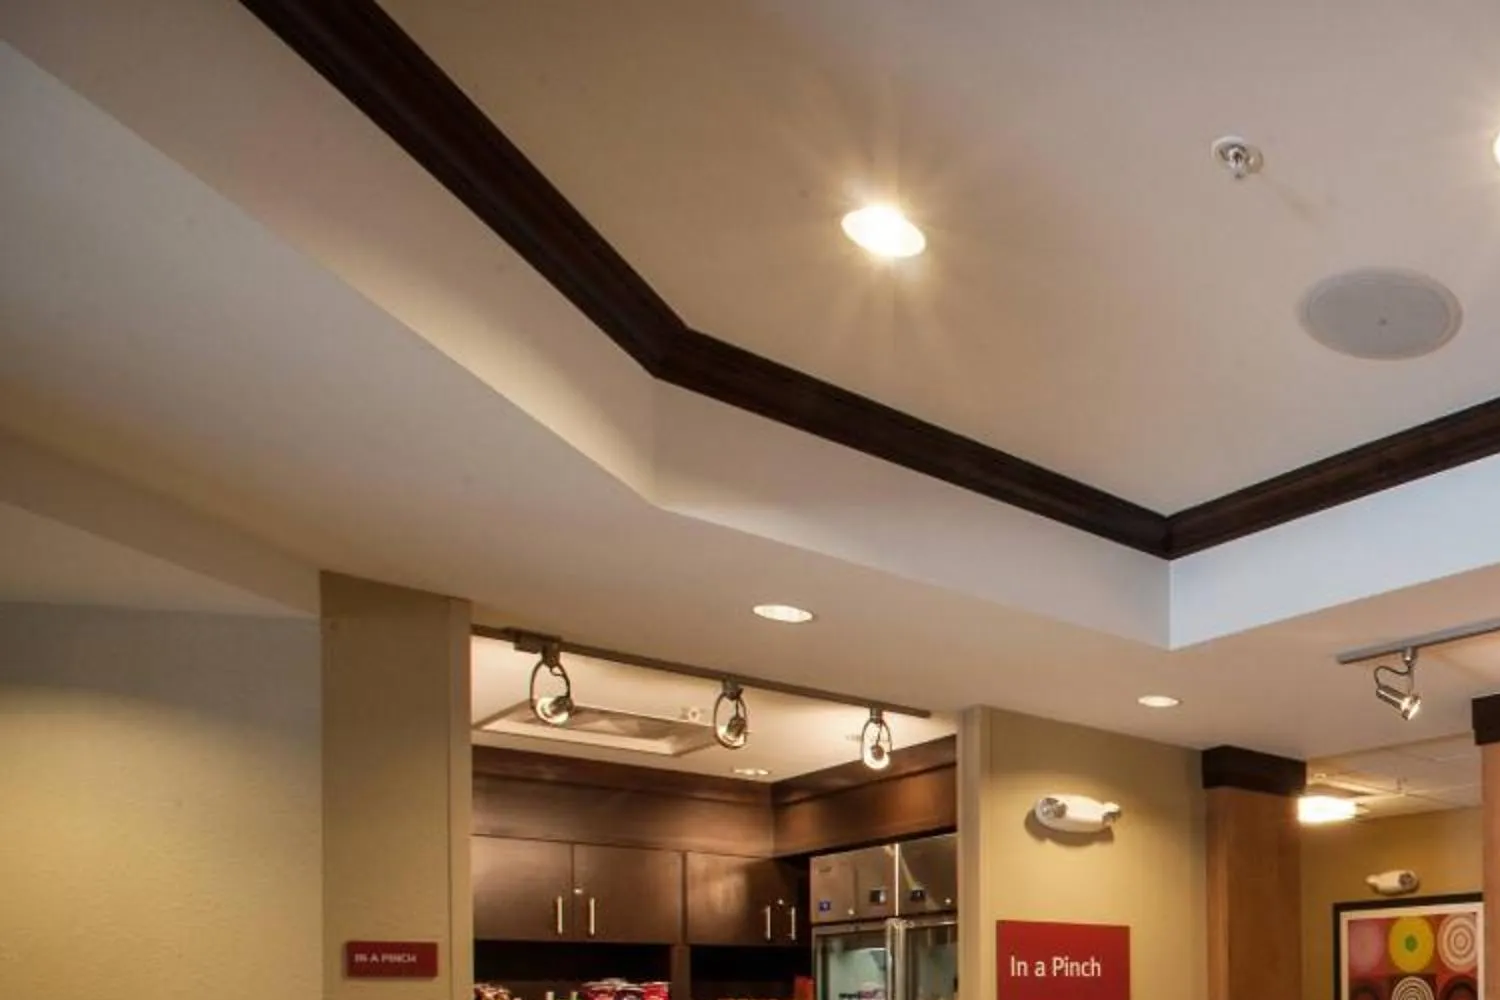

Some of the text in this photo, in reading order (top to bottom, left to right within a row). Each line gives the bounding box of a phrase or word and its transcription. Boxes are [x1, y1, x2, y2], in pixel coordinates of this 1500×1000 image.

[354, 953, 417, 963] IN A PINCH
[1010, 955, 1102, 977] In a Pinch
